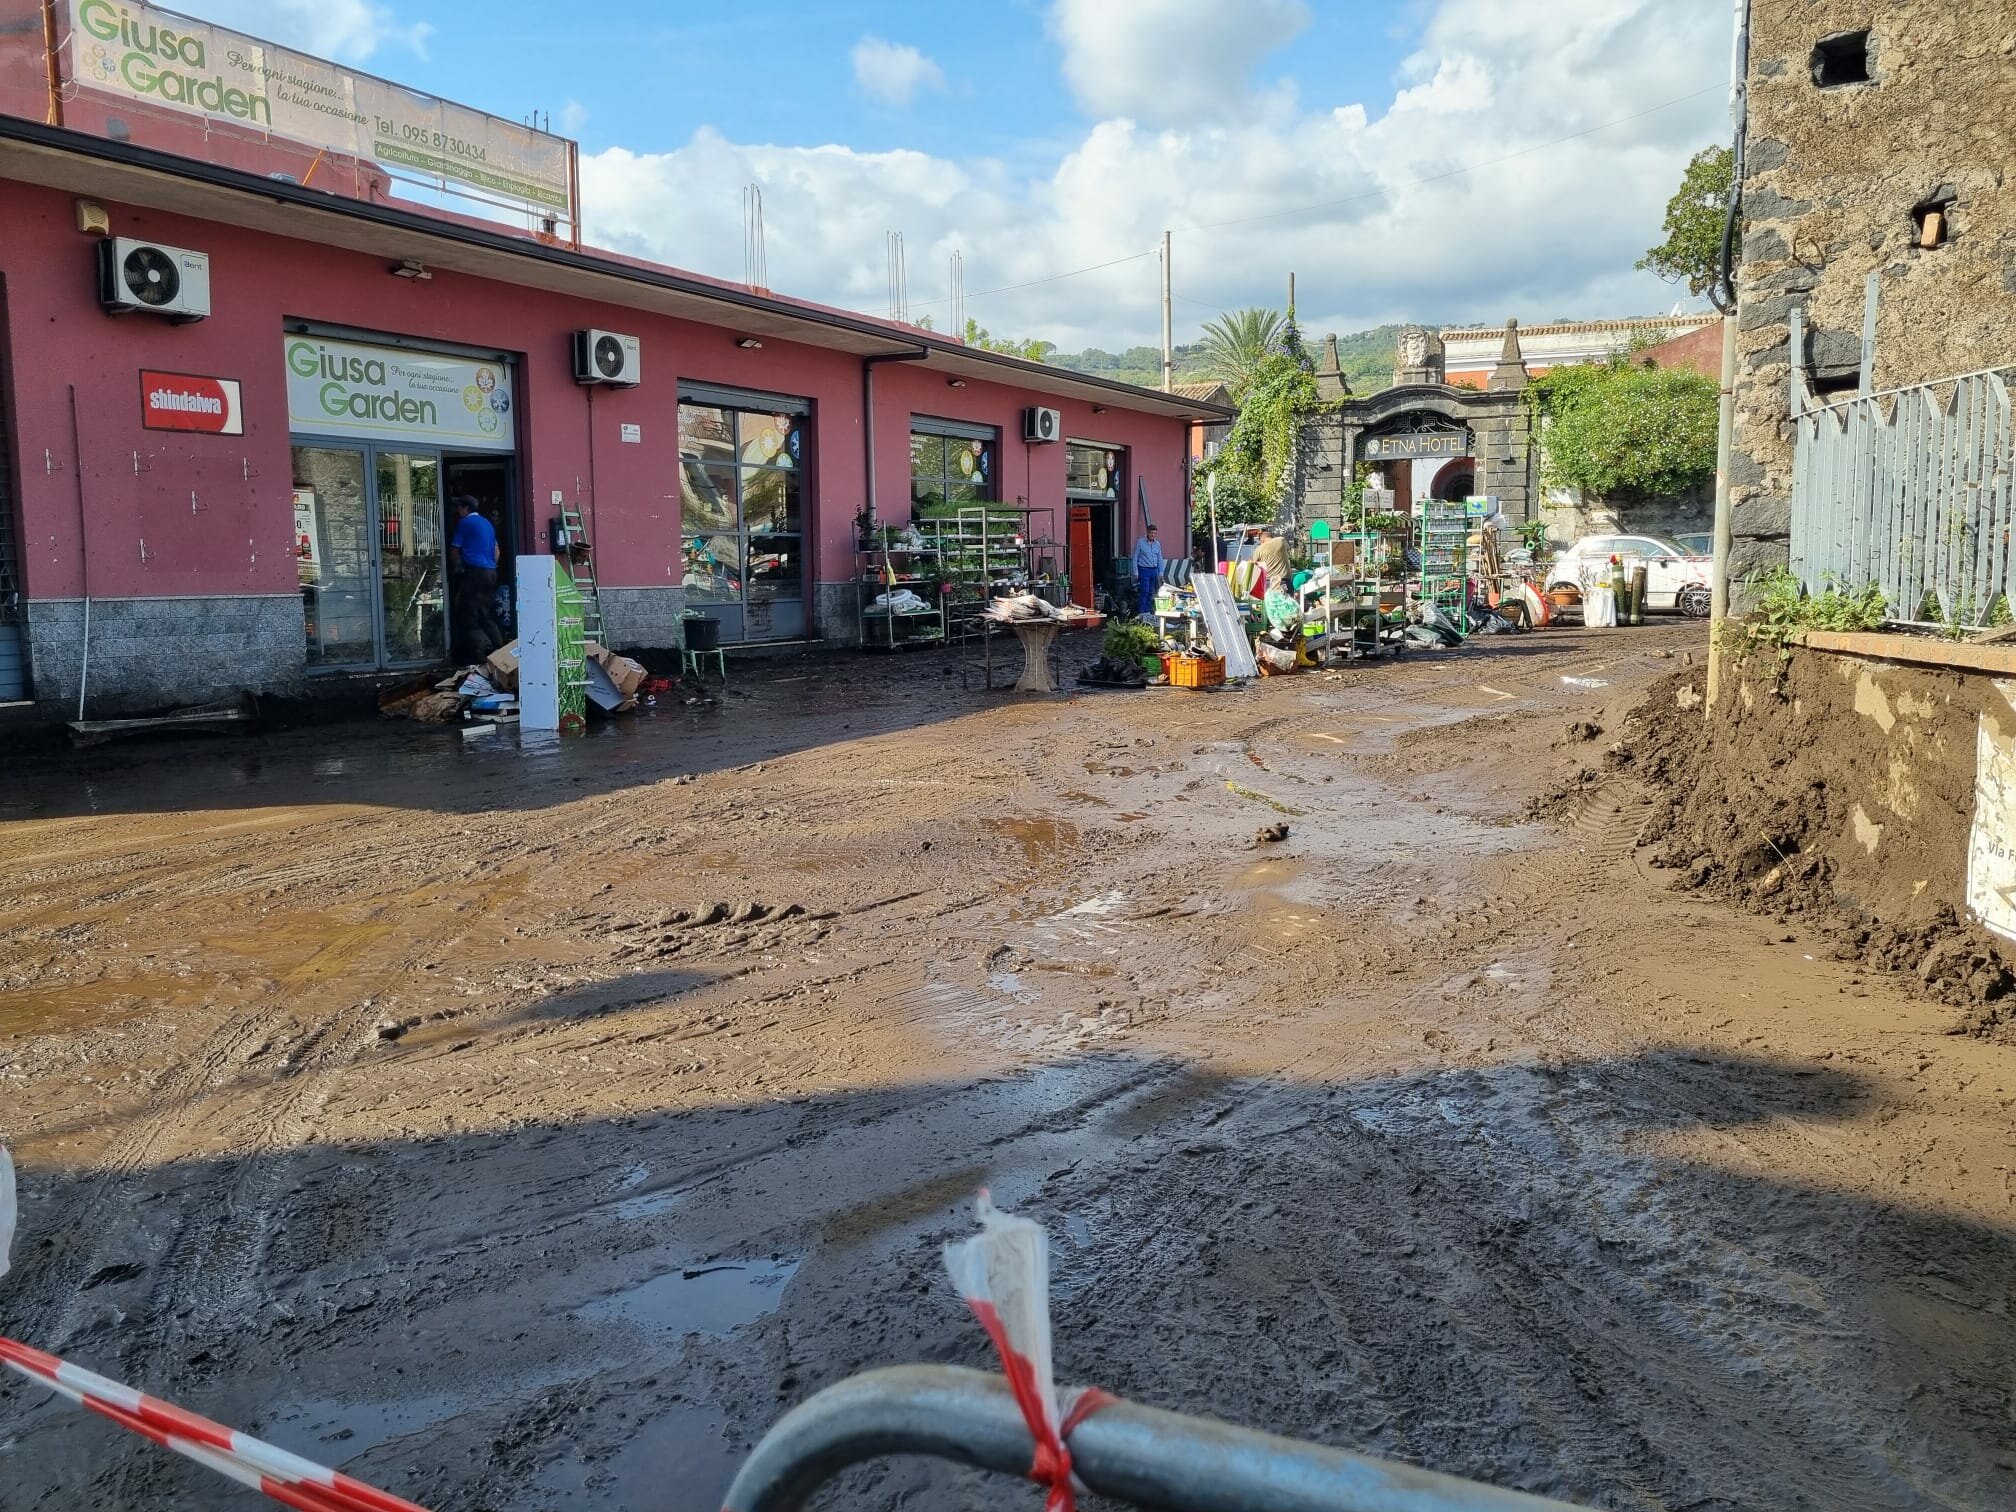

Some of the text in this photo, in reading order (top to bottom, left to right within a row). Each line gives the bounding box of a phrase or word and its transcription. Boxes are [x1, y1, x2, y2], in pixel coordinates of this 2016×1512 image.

[79, 0, 206, 69] Giusa
[227, 51, 256, 72] Per
[258, 66, 286, 82] ogni
[121, 52, 272, 125] Garden
[277, 84, 368, 125] la tua occasione
[374, 115, 487, 162] Tel. 095 8730434
[288, 342, 386, 385] Giusa
[391, 365, 406, 376] Per
[150, 388, 222, 415] shindaiwa
[320, 382, 437, 424] Garden
[408, 377, 416, 388] la
[429, 385, 458, 393] occasione
[1382, 436, 1465, 453] ETNA HOTEL
[1989, 840, 2004, 858] Via
